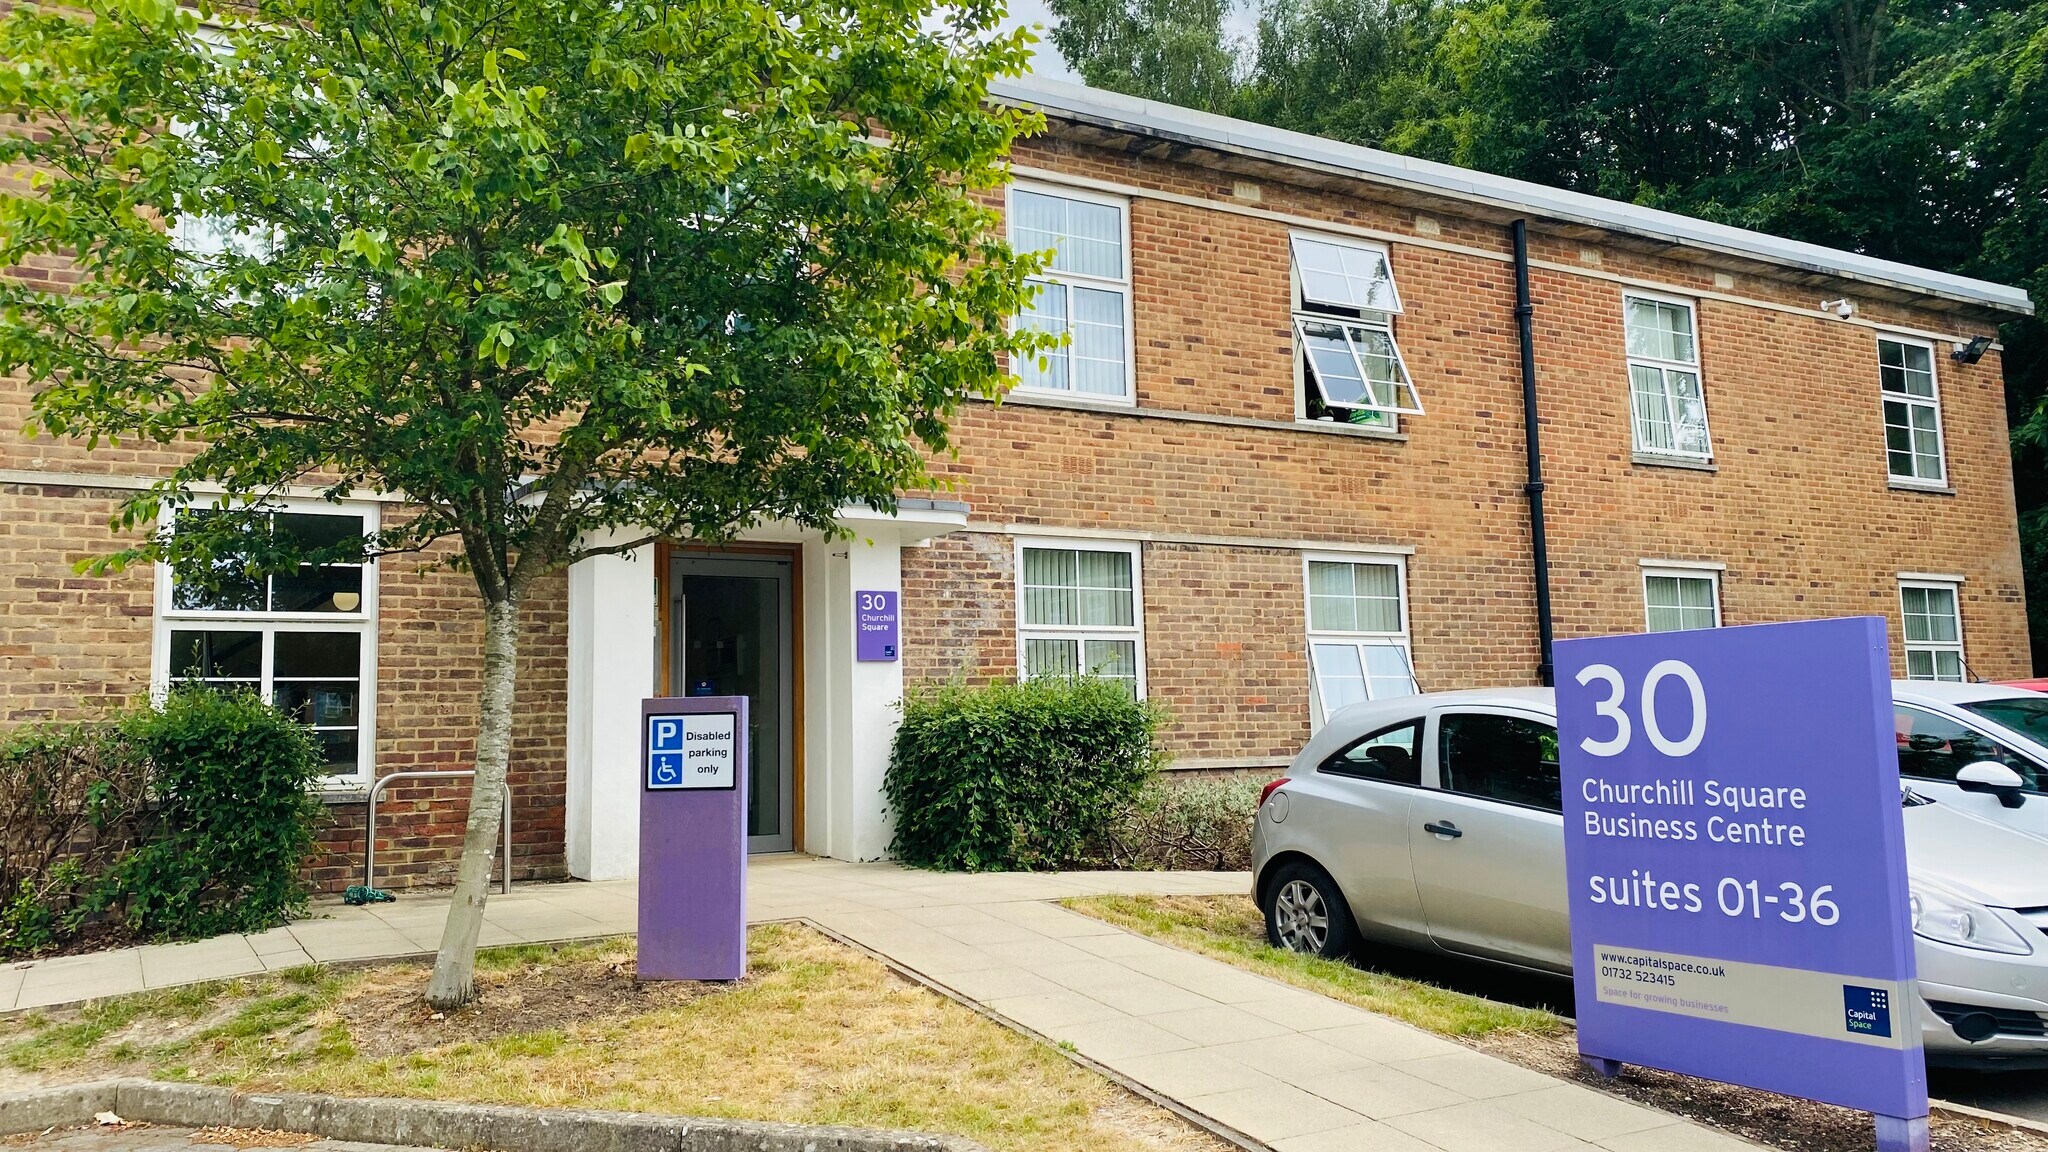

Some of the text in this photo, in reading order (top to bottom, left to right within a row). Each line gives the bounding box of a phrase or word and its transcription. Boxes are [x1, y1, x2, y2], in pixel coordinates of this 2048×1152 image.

[861, 594, 886, 610] 30
[861, 614, 895, 622] Churchill
[861, 623, 889, 632] Square
[1575, 660, 1707, 757] 30
[657, 722, 677, 748] P
[686, 731, 731, 741] Disabled
[688, 748, 728, 759] parking
[697, 765, 719, 775] only
[1582, 778, 1807, 813] Churchill Square
[1584, 811, 1806, 847] Business Centre
[1589, 869, 1840, 926] suites 01-36
[1600, 953, 1726, 977] www.capitalspace.co.uk
[1601, 966, 1675, 986] 01732 523415
[1603, 986, 1729, 1013] Space for growing businesses
[1847, 1009, 1877, 1020] Capital
[1848, 1019, 1872, 1030] Space
